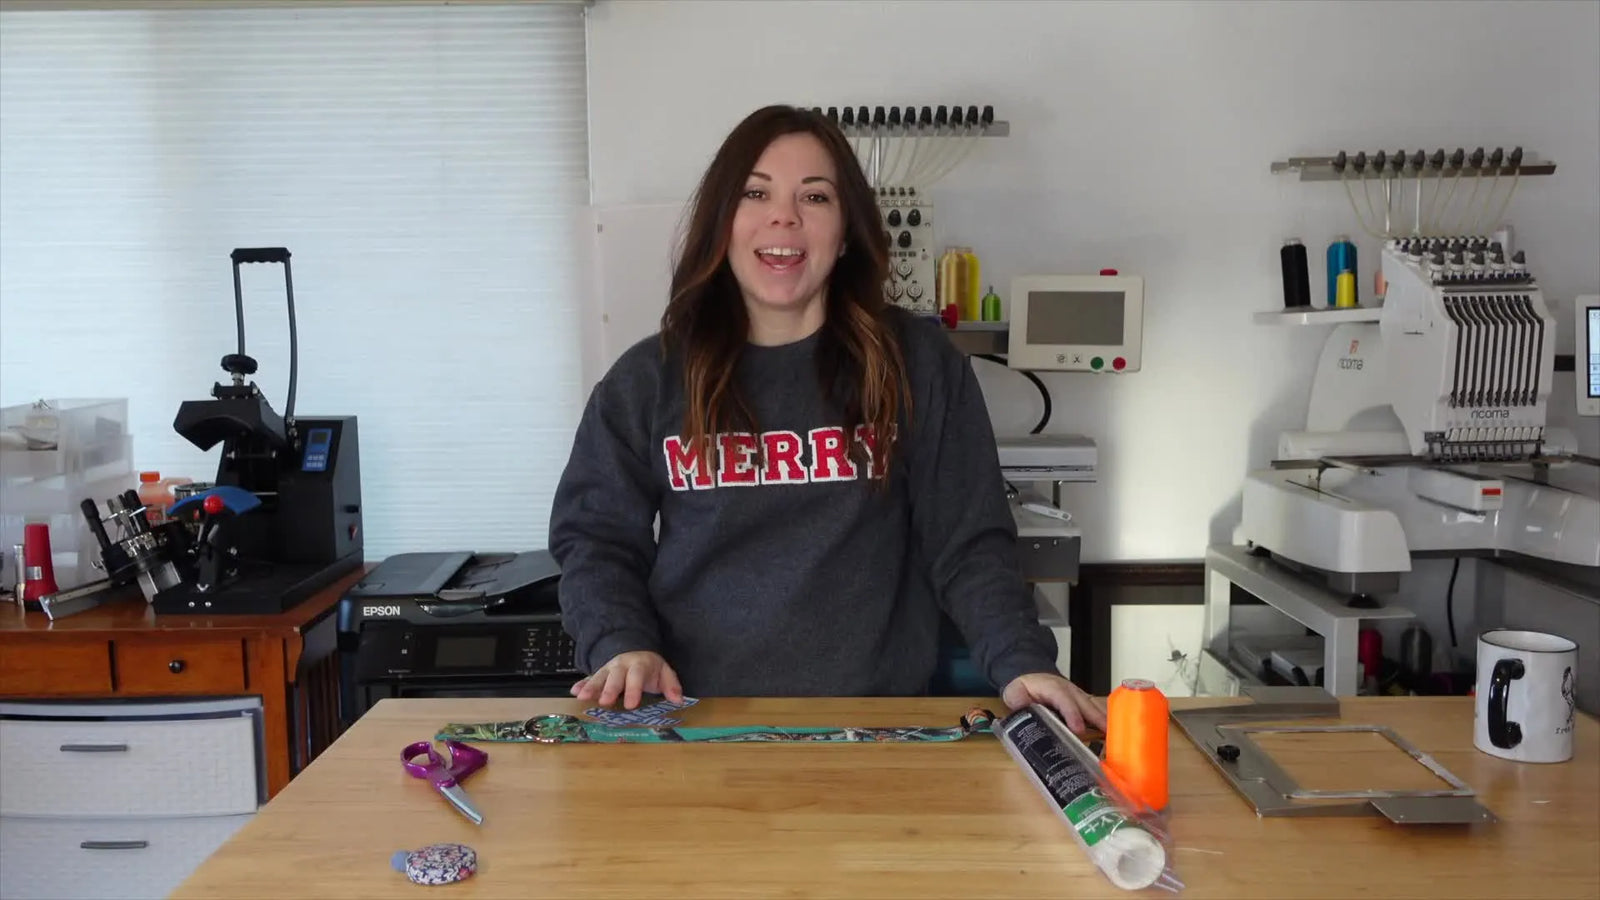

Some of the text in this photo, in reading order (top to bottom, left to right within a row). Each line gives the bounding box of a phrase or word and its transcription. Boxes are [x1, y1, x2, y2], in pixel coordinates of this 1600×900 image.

[1471, 409, 1509, 419] ricoma
[663, 424, 897, 491] MERRY
[363, 606, 400, 616] EPSON
